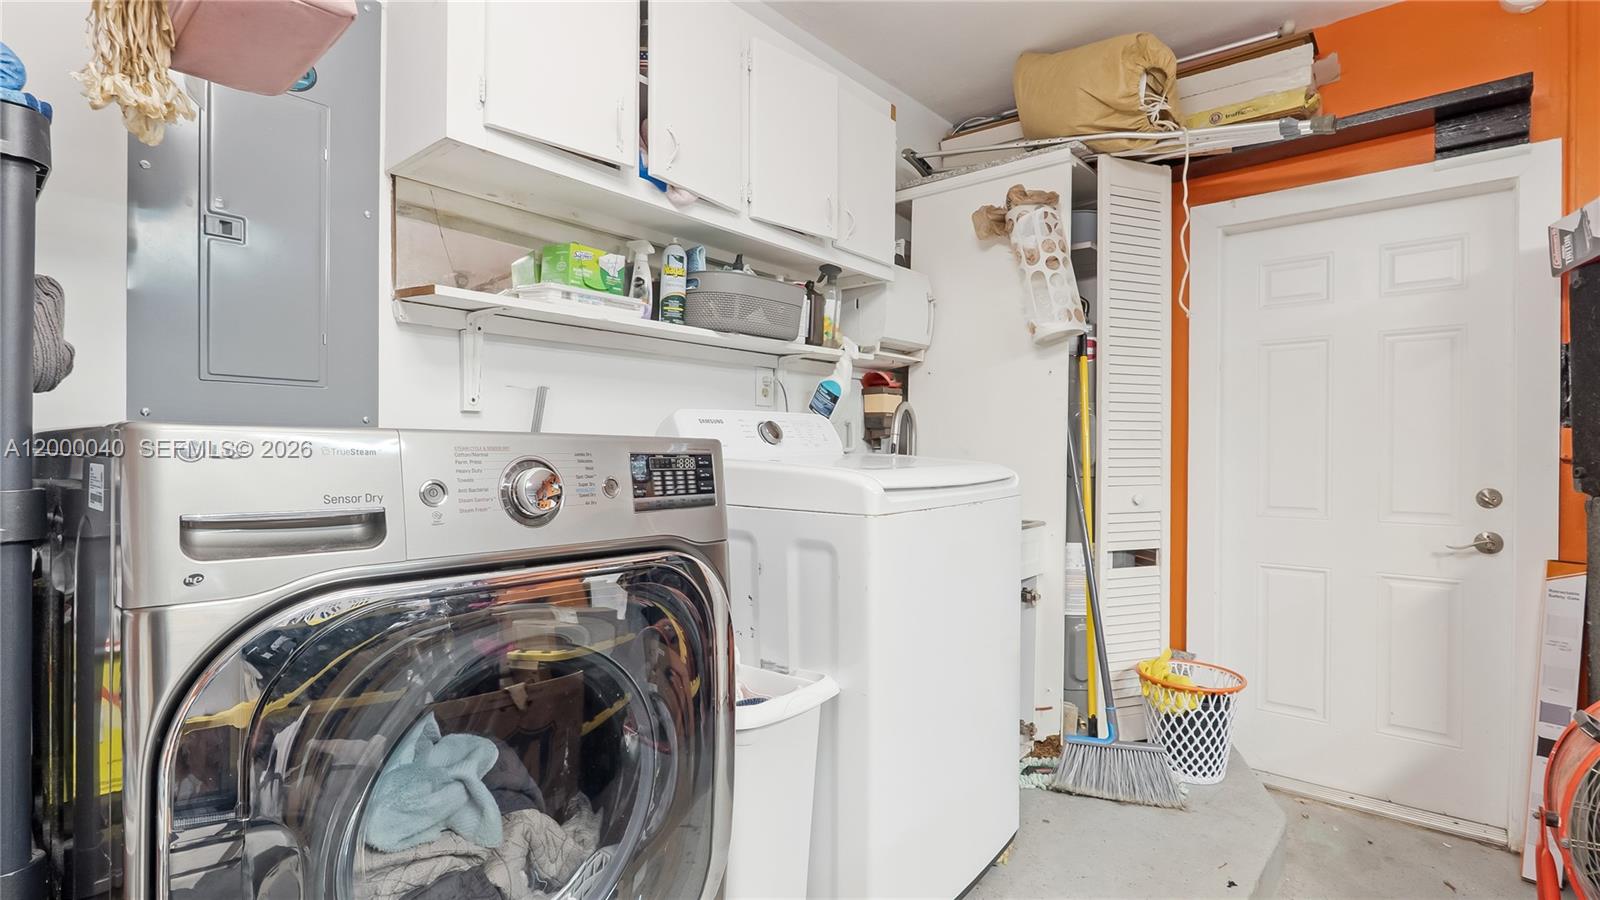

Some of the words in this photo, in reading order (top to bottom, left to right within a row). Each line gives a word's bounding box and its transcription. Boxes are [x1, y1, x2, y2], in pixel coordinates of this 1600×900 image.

[330, 448, 377, 456] TrueSteam
[323, 494, 363, 504] Sensor
[365, 493, 384, 504] Dry
